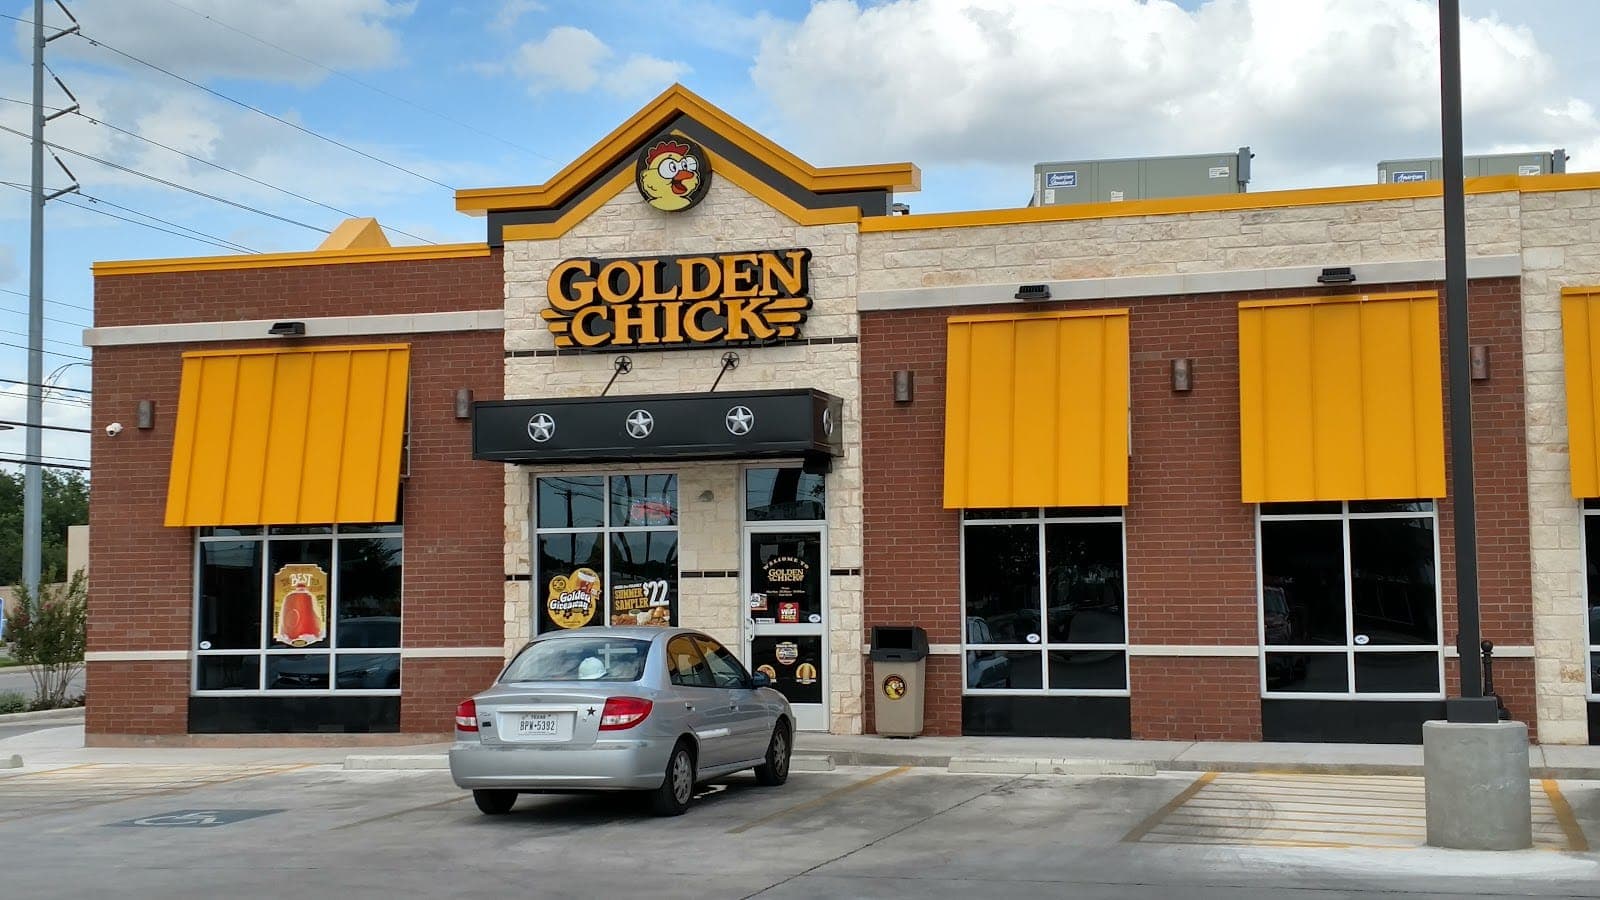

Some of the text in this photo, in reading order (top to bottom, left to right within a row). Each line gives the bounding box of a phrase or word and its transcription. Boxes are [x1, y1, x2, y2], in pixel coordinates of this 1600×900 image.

[547, 250, 805, 311] GOLDEN
[571, 298, 776, 347] CHICK
[768, 568, 804, 577] GOLDEN
[289, 573, 313, 587] BEST
[560, 590, 591, 603] Golden
[614, 588, 643, 599] SUMMER
[642, 580, 670, 607] $22
[550, 599, 589, 611] Giveaway
[615, 597, 649, 611] SAMPLER
